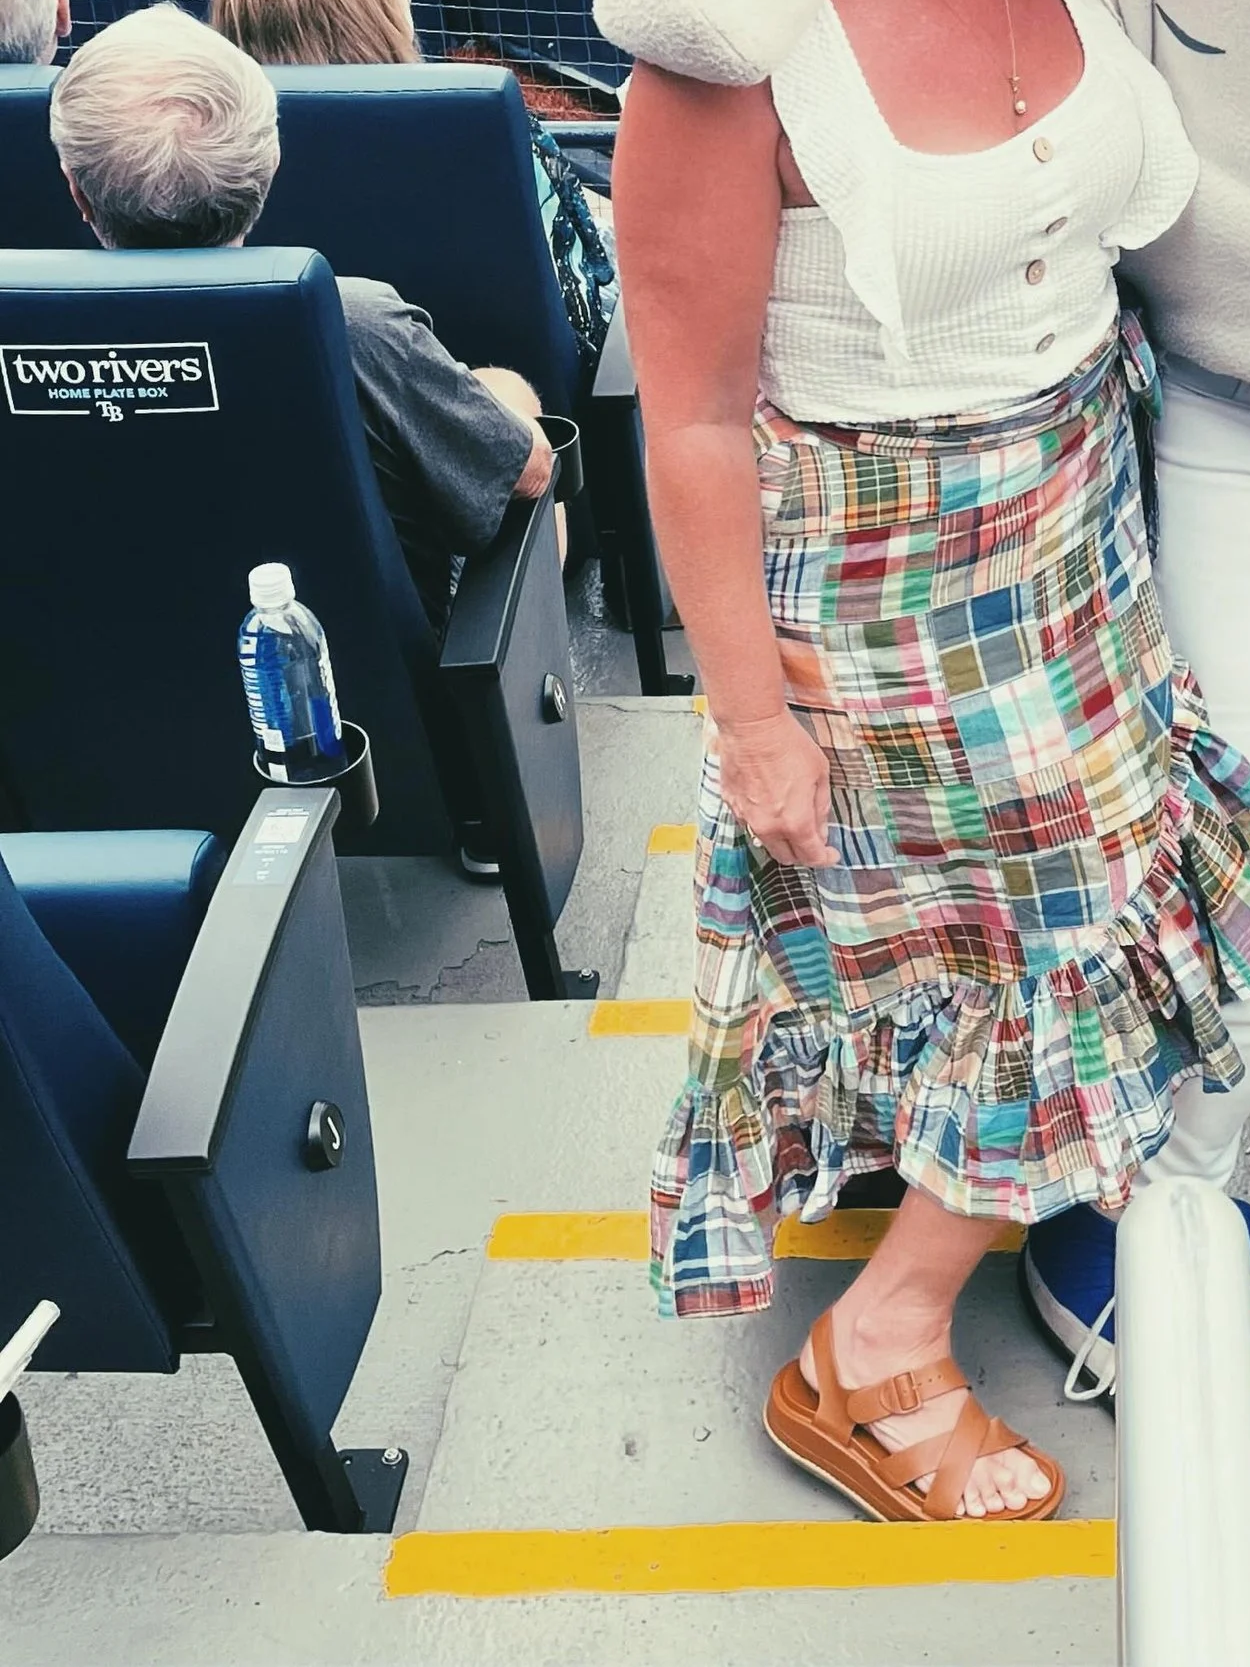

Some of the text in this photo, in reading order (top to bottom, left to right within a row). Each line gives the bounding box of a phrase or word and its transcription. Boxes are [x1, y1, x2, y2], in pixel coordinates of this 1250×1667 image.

[12, 350, 203, 384] two rivers
[48, 387, 168, 399] HOME PLATE BOX
[327, 1116, 341, 1150] J
